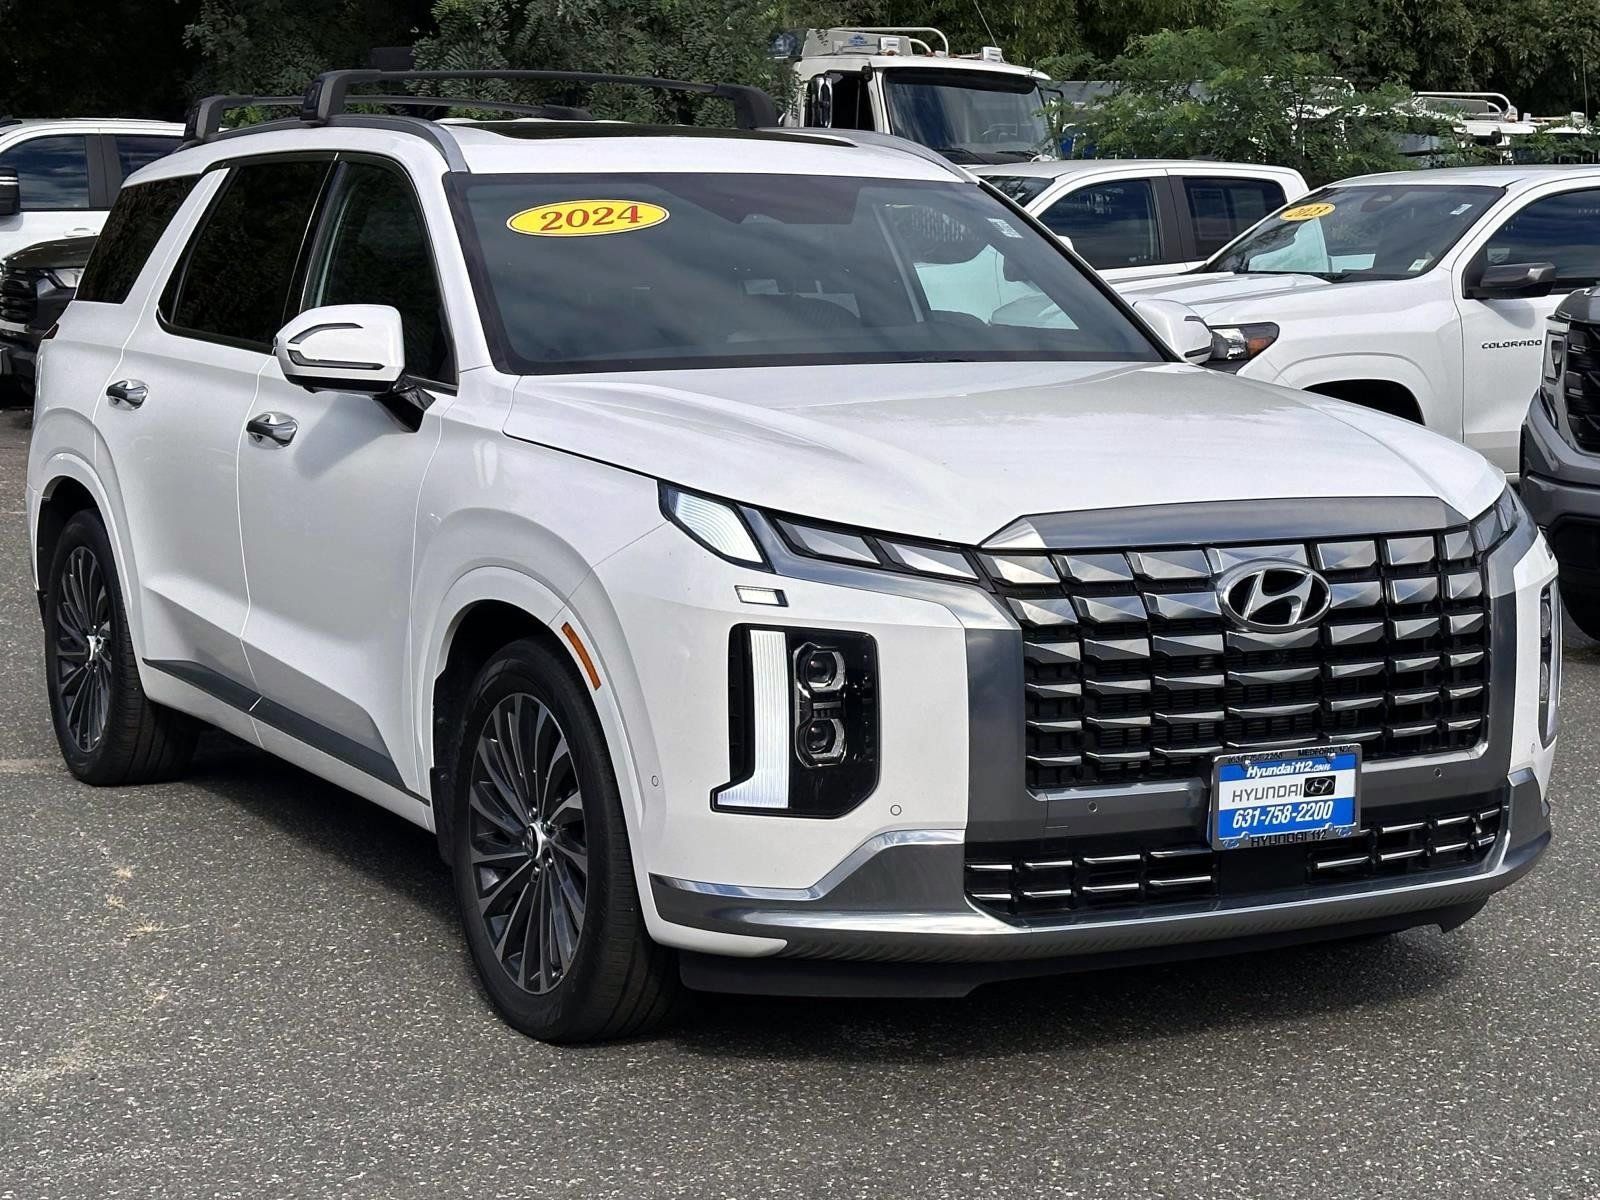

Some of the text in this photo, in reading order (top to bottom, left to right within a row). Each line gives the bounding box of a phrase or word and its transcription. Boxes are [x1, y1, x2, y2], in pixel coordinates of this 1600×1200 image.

[540, 205, 643, 231] 2024
[1481, 339, 1543, 349] COLORADO
[1232, 783, 1303, 803] HYUNDAI
[1232, 801, 1334, 829] 631-758-2200
[1251, 832, 1307, 847] HYUNDAI
